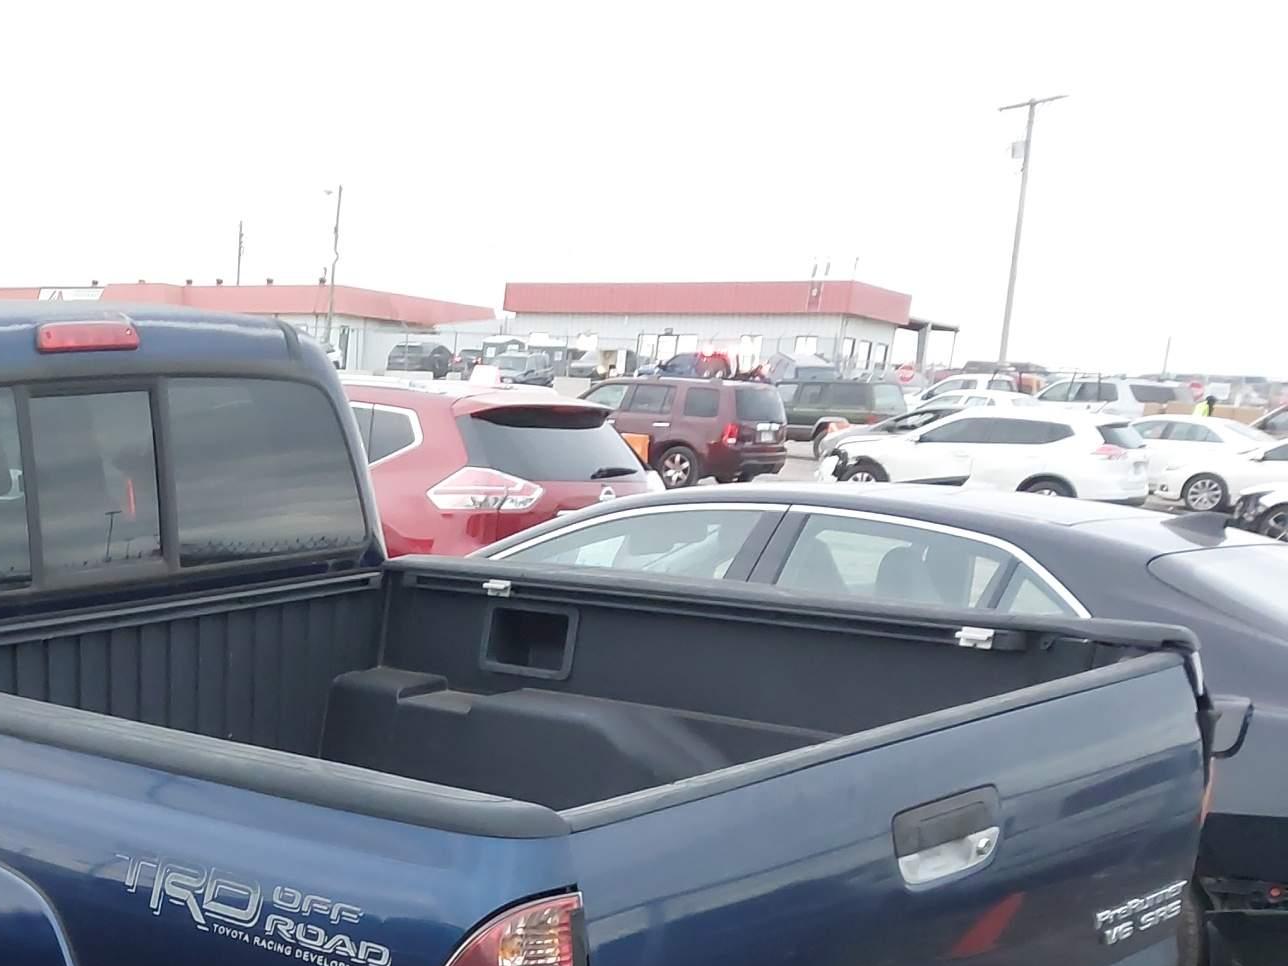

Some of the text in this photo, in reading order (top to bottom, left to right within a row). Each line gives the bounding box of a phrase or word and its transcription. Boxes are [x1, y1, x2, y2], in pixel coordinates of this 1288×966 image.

[115, 853, 363, 932] TRD OFF
[212, 923, 249, 943] TOYOTA
[253, 935, 292, 957] RACING
[1104, 921, 1134, 945] V6
